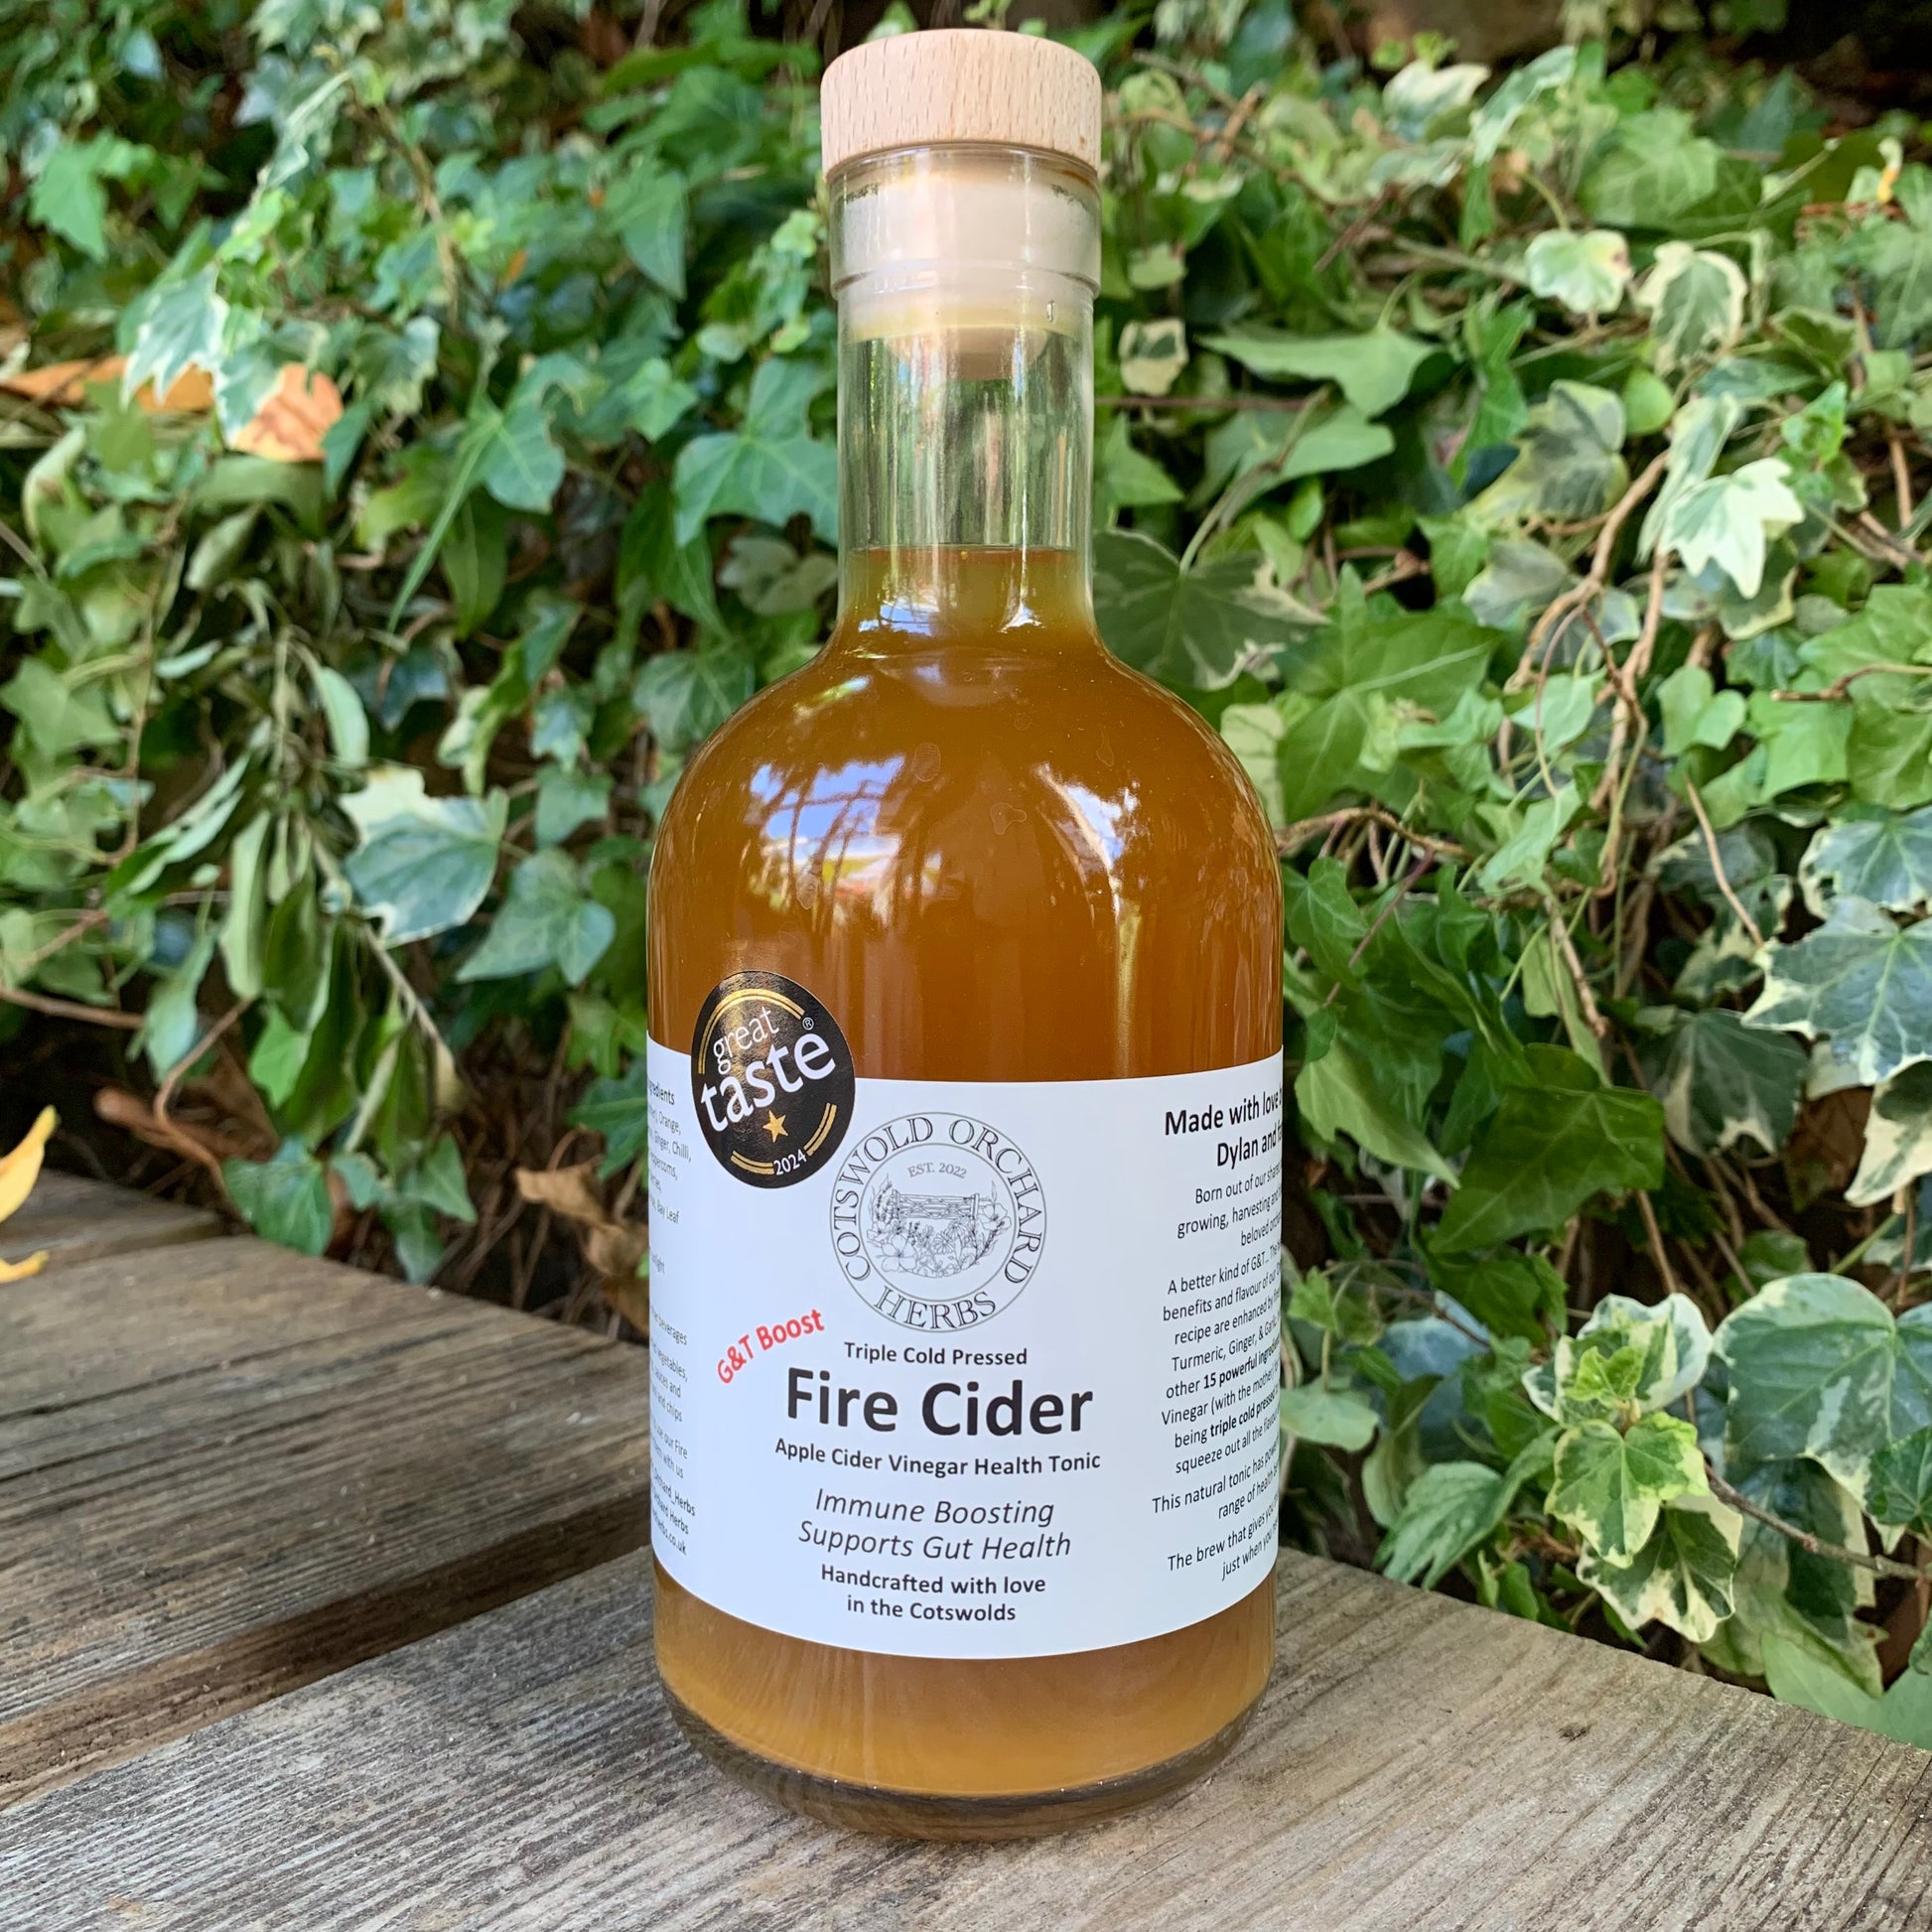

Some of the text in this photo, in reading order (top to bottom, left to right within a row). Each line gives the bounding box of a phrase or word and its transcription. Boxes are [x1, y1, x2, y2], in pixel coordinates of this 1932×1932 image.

[713, 1006, 779, 1075] great
[701, 1033, 836, 1132] taste
[1165, 1104, 1224, 1136] Made
[1229, 1095, 1260, 1125] with
[1263, 1091, 1279, 1116] love
[773, 1149, 807, 1175] 2024
[1217, 1137, 1259, 1171] Dylan
[1261, 1122, 1276, 1153] and
[907, 1162, 967, 1179] EST. 2022
[1195, 1186, 1222, 1204] Born
[1225, 1180, 1242, 1197] out
[1244, 1173, 1254, 1191] of
[1254, 1172, 1266, 1187] our
[834, 1116, 1042, 1284] COTSWOLD ORCHARD
[1177, 1211, 1229, 1239] growing,
[1232, 1195, 1271, 1222] harvesting
[1241, 1218, 1270, 1246] beloved
[1168, 1279, 1177, 1295] A
[1180, 1272, 1216, 1293] better
[1219, 1262, 1239, 1283] kind
[1241, 1258, 1250, 1275] of
[874, 1285, 997, 1329] HERBS
[1163, 1297, 1212, 1321] benefits
[1215, 1289, 1233, 1310] and
[1235, 1280, 1262, 1303] flavour
[1174, 1326, 1211, 1346] recipe
[1213, 1317, 1230, 1333] are
[1232, 1297, 1267, 1328] enhanced
[659, 1315, 688, 1345] beverages
[717, 1309, 825, 1384] G&T Boost
[1172, 1346, 1226, 1372] Turmeric,
[1228, 1333, 1258, 1355] Ginger,
[1258, 1325, 1264, 1340] &
[844, 1341, 1028, 1366] Triple Cold Pressed
[669, 1381, 681, 1398] and
[1166, 1379, 1200, 1399] other
[1203, 1372, 1216, 1390] 15
[1219, 1352, 1258, 1385] powerful
[666, 1400, 682, 1422] chips
[786, 1366, 1094, 1437] Fire Cider
[1161, 1400, 1208, 1426] Vinegar
[1210, 1390, 1237, 1416] (with
[1238, 1384, 1251, 1402] the
[1174, 1427, 1208, 1449] being
[1210, 1414, 1237, 1440] triple
[1238, 1402, 1255, 1426] cold
[675, 1439, 687, 1459] Fire
[774, 1437, 1102, 1478] Apple Cider Vinegar Health Tonic
[1175, 1449, 1222, 1475] squeeze
[1224, 1439, 1241, 1457] out
[1242, 1430, 1251, 1449] all
[1252, 1425, 1263, 1443] the
[676, 1463, 684, 1478] us
[1152, 1495, 1180, 1514] This
[1184, 1474, 1226, 1506] natural
[1228, 1464, 1251, 1488] tonic
[1253, 1455, 1264, 1474] has
[669, 1508, 689, 1535] Herbs
[815, 1487, 1055, 1528] Immune Boosting
[1218, 1500, 1245, 1520] range
[1247, 1482, 1256, 1504] of
[798, 1519, 1072, 1561] Supports Gut Health
[1168, 1551, 1192, 1572] The
[1196, 1540, 1225, 1563] brew
[1227, 1526, 1247, 1549] that
[1248, 1512, 1265, 1540] gives
[1221, 1558, 1240, 1582] just
[1242, 1539, 1262, 1566] when
[821, 1564, 1046, 1594] Handcrafted with love
[847, 1594, 1017, 1621] in the Cotswolds
